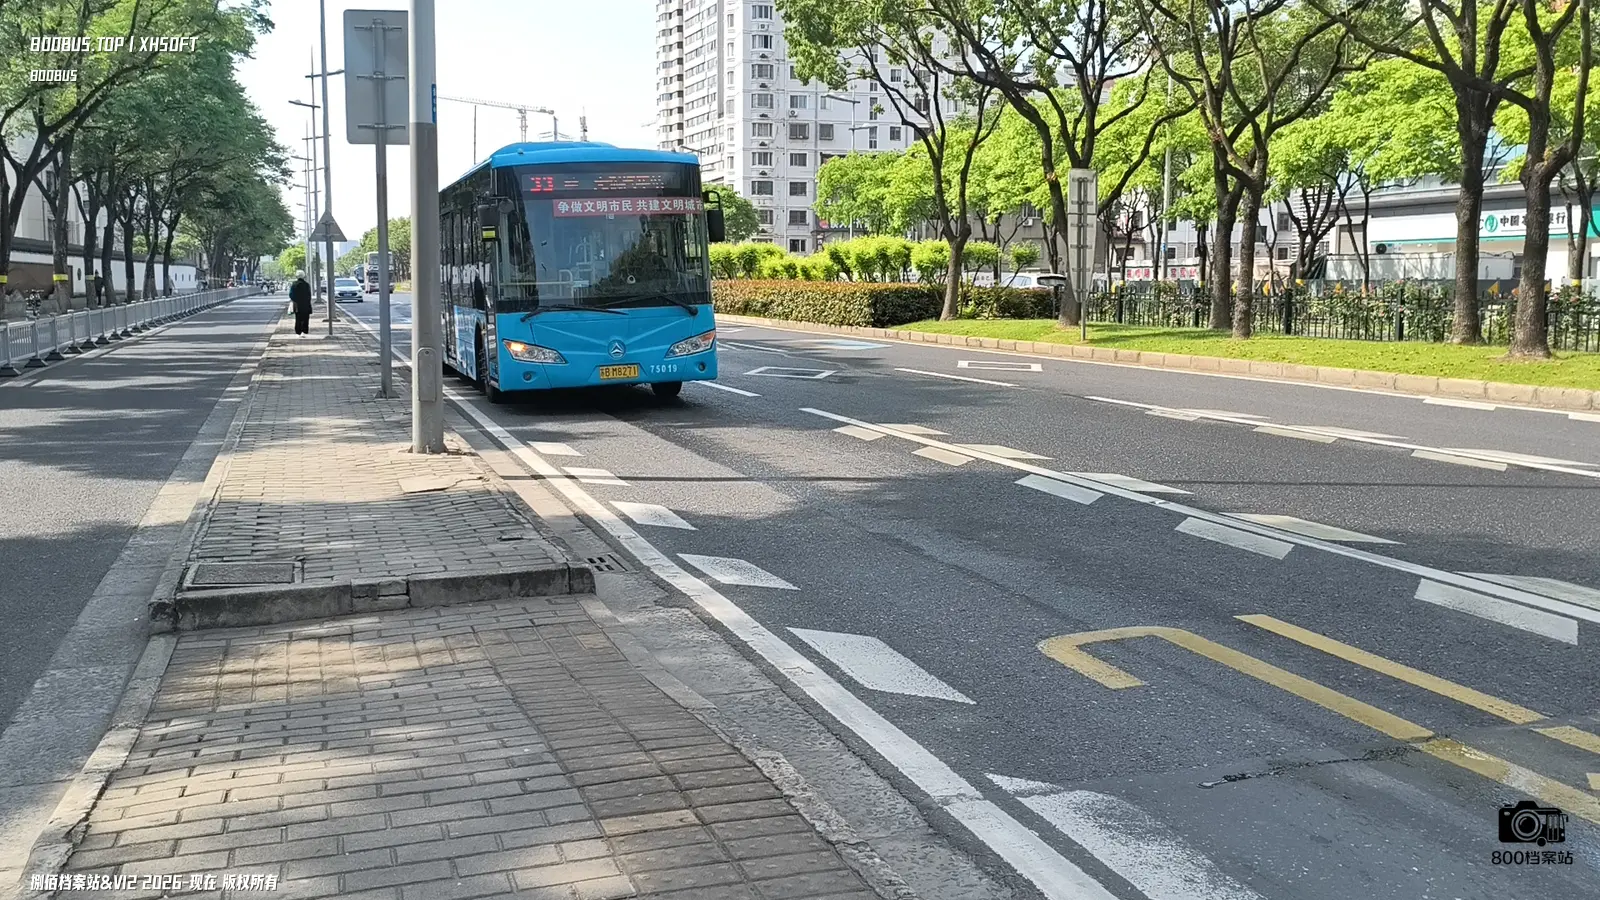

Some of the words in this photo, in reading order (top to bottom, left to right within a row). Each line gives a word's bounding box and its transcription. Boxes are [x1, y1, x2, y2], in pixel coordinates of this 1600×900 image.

[557, 200, 633, 213] 争做文明市民
[650, 364, 678, 373] 75019
